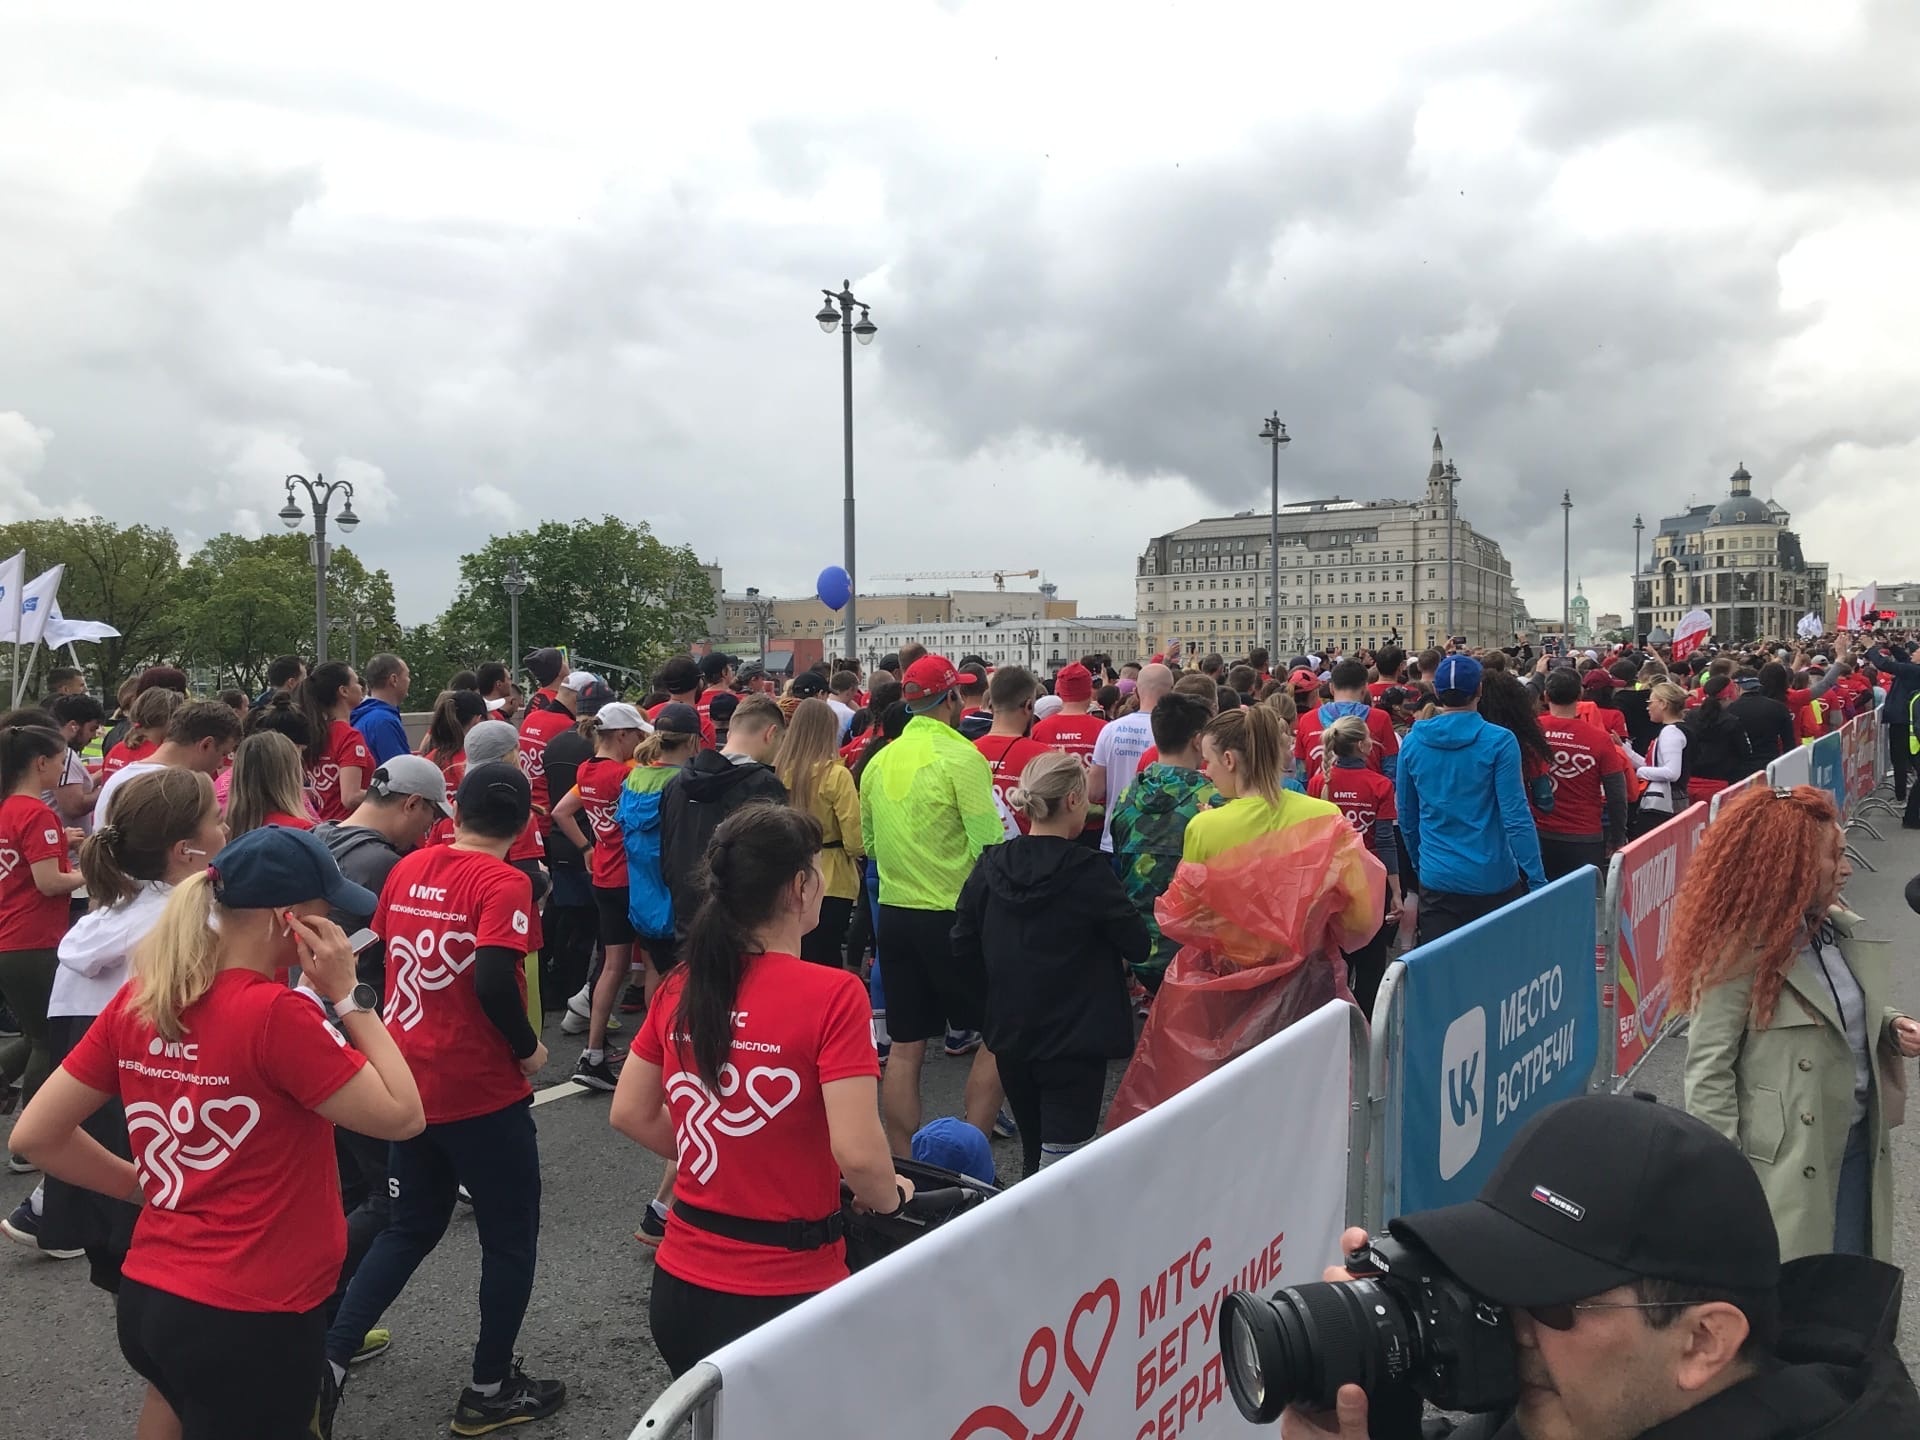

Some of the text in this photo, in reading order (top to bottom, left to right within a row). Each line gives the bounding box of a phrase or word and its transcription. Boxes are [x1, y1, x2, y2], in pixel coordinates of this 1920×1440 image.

[1061, 732, 1082, 740] МТС
[1116, 726, 1147, 735] Abbott
[1551, 731, 1575, 740] МТС
[1114, 736, 1150, 748] Running
[416, 885, 448, 902] МТС
[1499, 964, 1563, 1051] МЕСТО
[1496, 1018, 1576, 1127] ВСТРЕЧИ
[1448, 1051, 1479, 1128] VK
[1549, 1195, 1580, 1217] RUSSIA
[1369, 1250, 1391, 1274] Nikon
[1138, 1236, 1212, 1340] МТС
